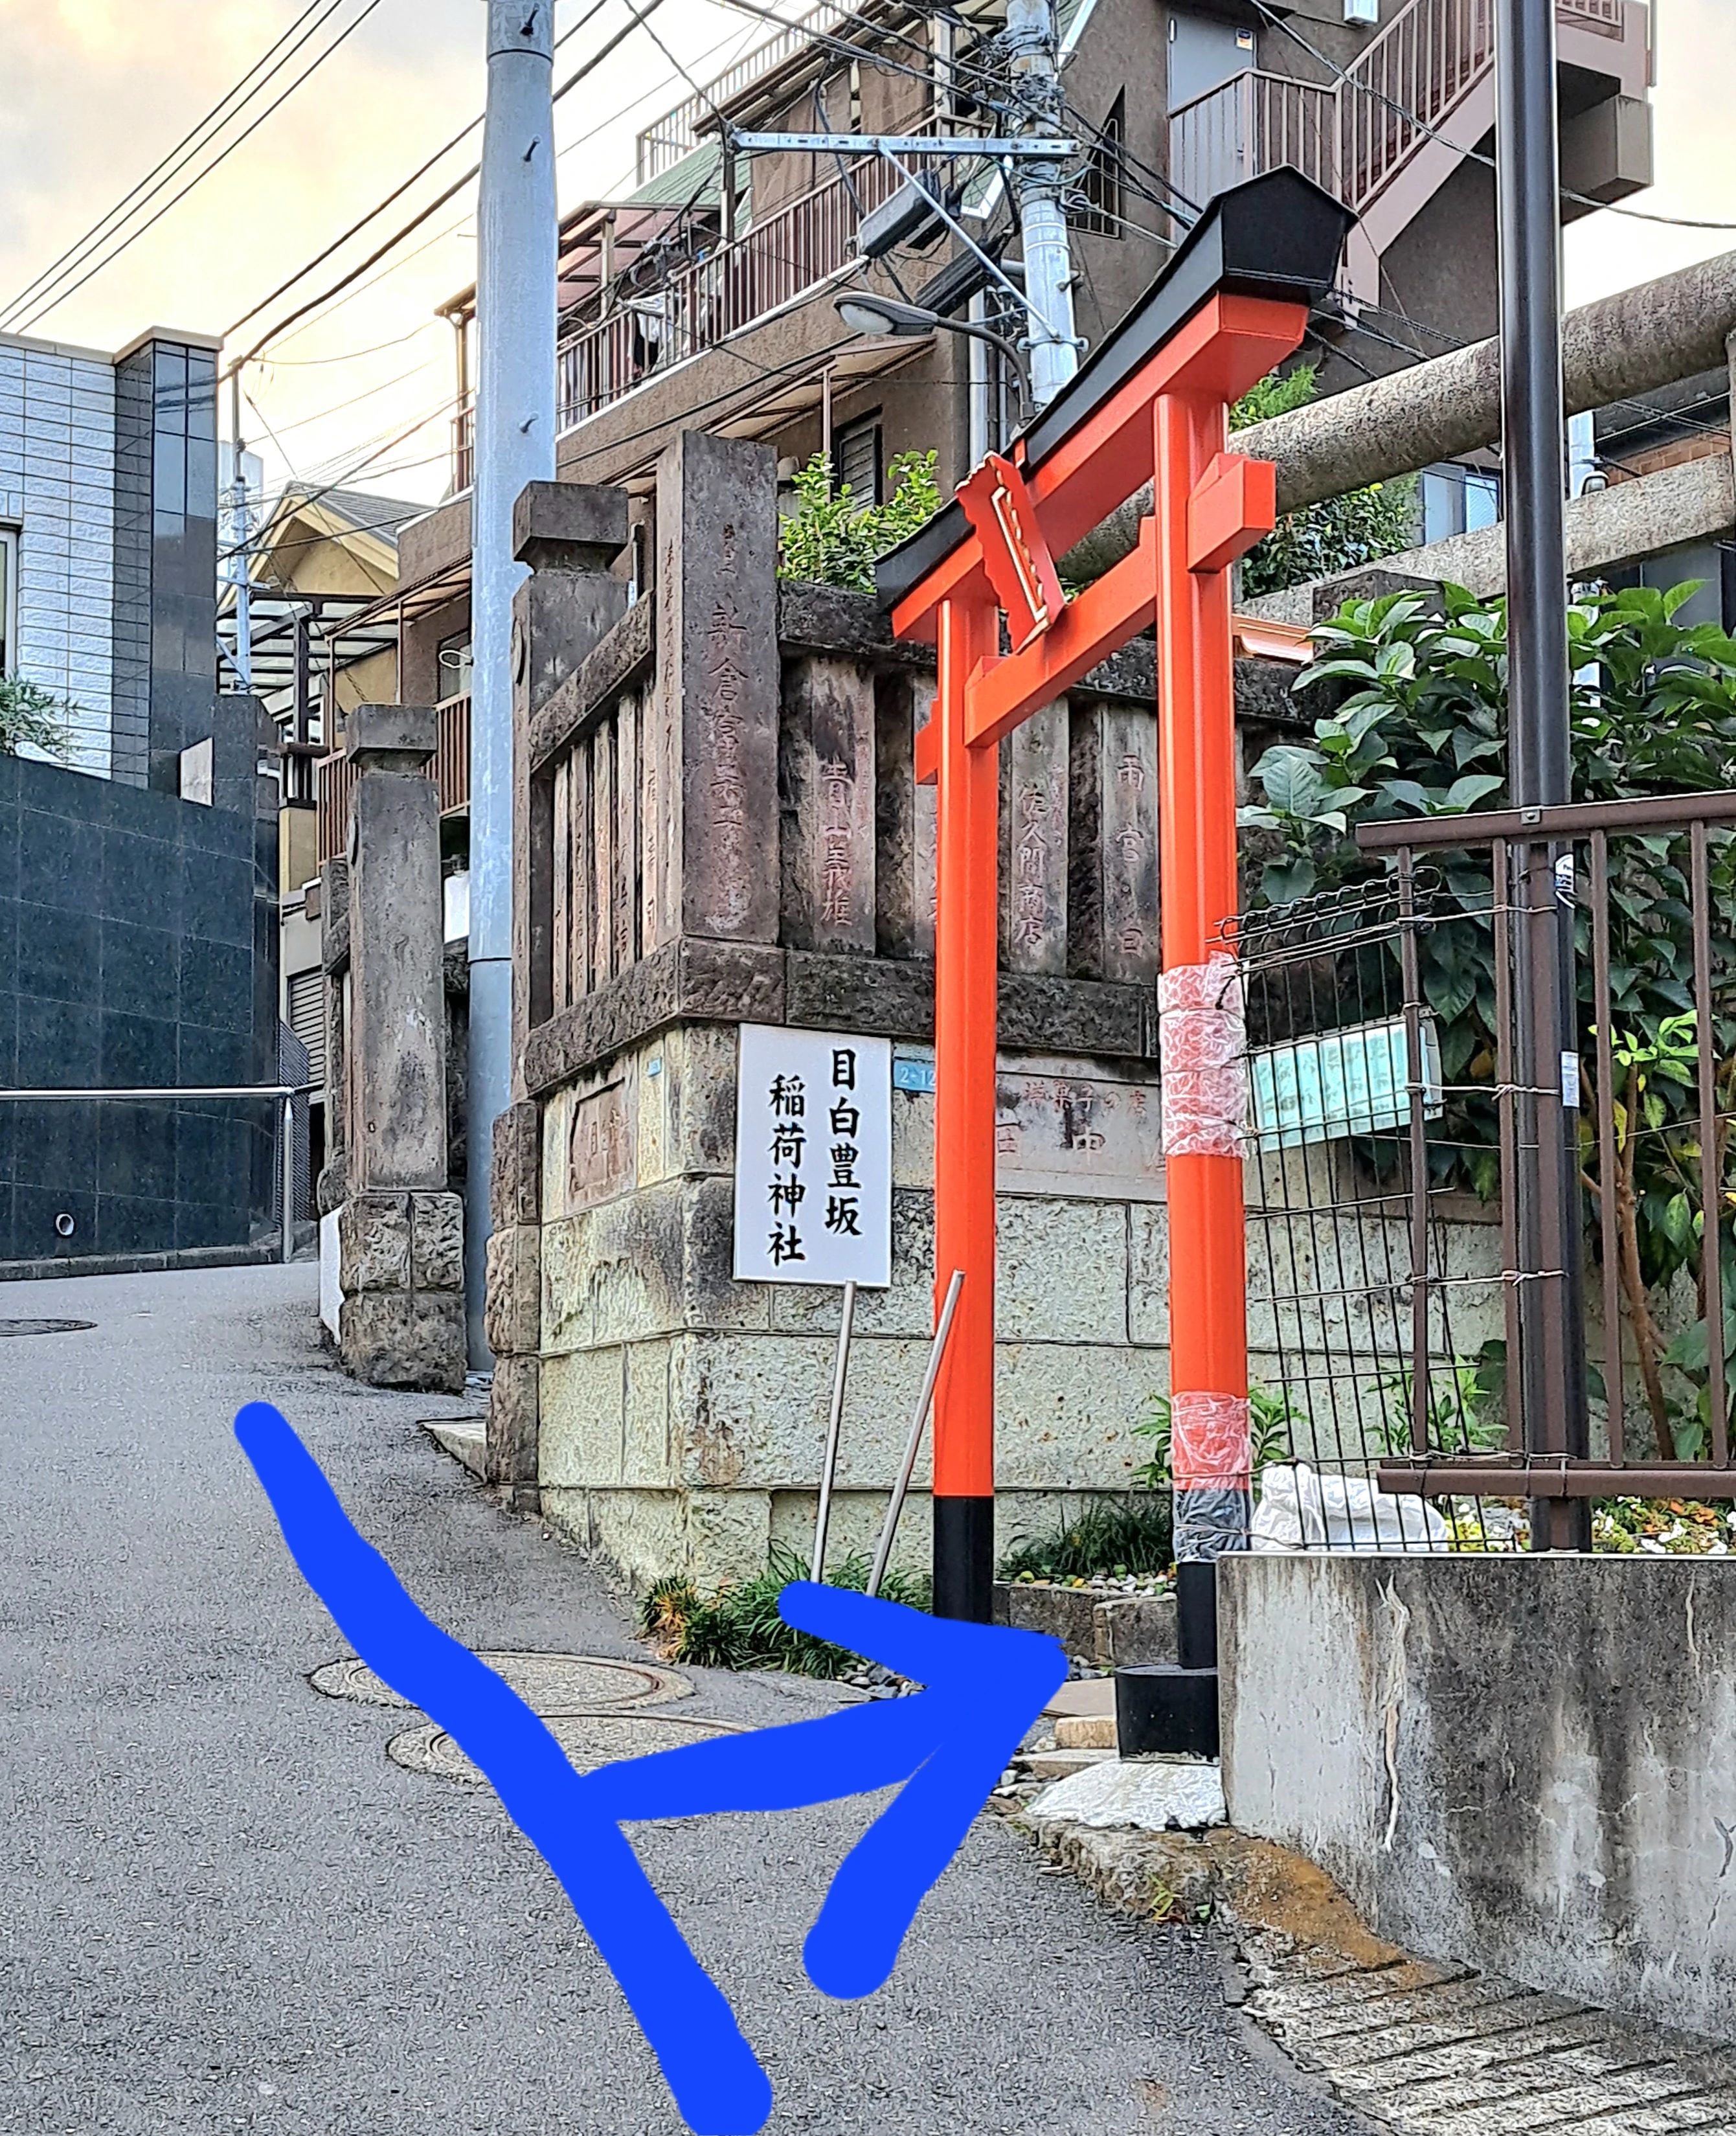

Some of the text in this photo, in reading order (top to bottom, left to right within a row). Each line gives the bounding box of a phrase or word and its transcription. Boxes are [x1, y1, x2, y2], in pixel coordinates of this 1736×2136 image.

[1015, 785, 1048, 944] 佐久間商店
[766, 1073, 807, 1267] 稲荷神社
[824, 1048, 862, 1236] 目白豊坂
[996, 1122, 1165, 1173] 田中
